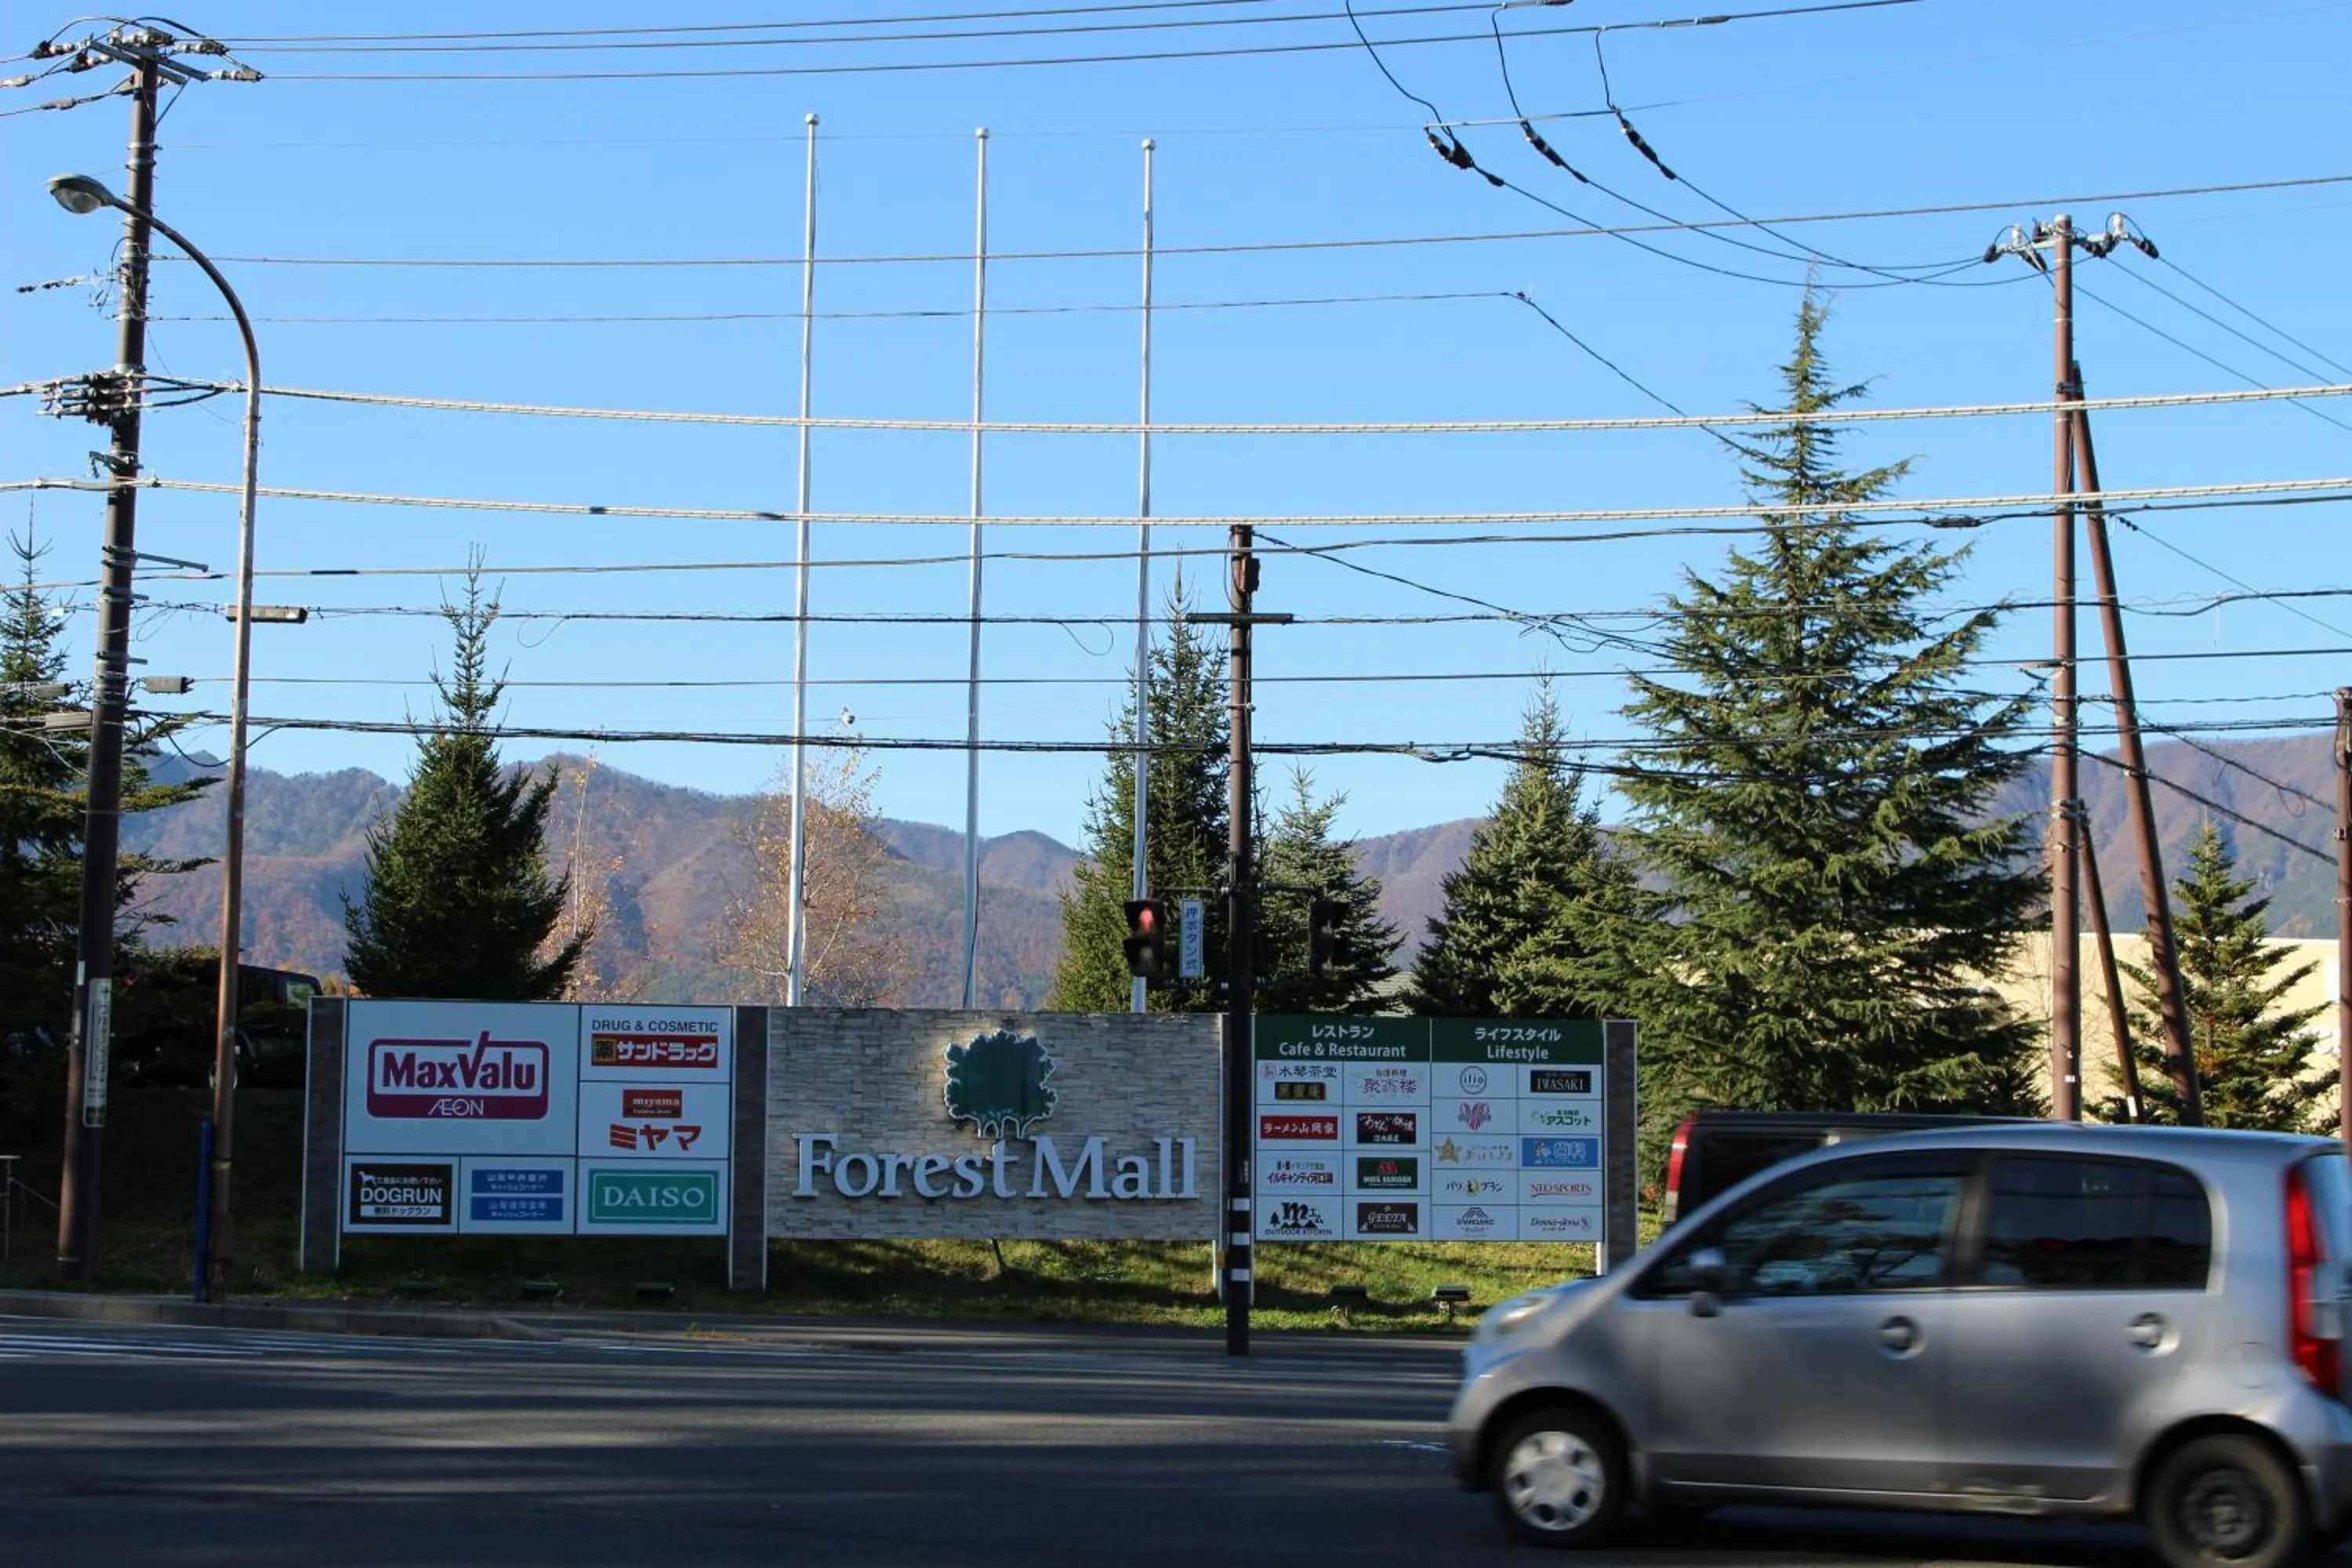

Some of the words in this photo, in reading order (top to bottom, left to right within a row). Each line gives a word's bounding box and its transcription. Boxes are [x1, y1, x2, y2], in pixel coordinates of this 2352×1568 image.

[592, 1020, 631, 1031] DRUG
[635, 1021, 644, 1031] &
[648, 1020, 719, 1033] COSMETIC
[1312, 1025, 1374, 1039] レストラン
[1475, 1028, 1562, 1042] ライフスタイル
[617, 1040, 717, 1062] サンドラッグ
[1279, 1042, 1310, 1055] Cafe
[1314, 1042, 1325, 1056] &
[1329, 1042, 1406, 1057] Restaurant
[1487, 1044, 1548, 1062] Lifestyle
[382, 1030, 536, 1090] MaxValu
[1537, 1078, 1584, 1091] IWASAKI
[1546, 1116, 1592, 1127] アスコット
[610, 1123, 702, 1151] ミヤマ
[360, 1188, 443, 1203] DOGRUN
[604, 1186, 705, 1207] DAISO
